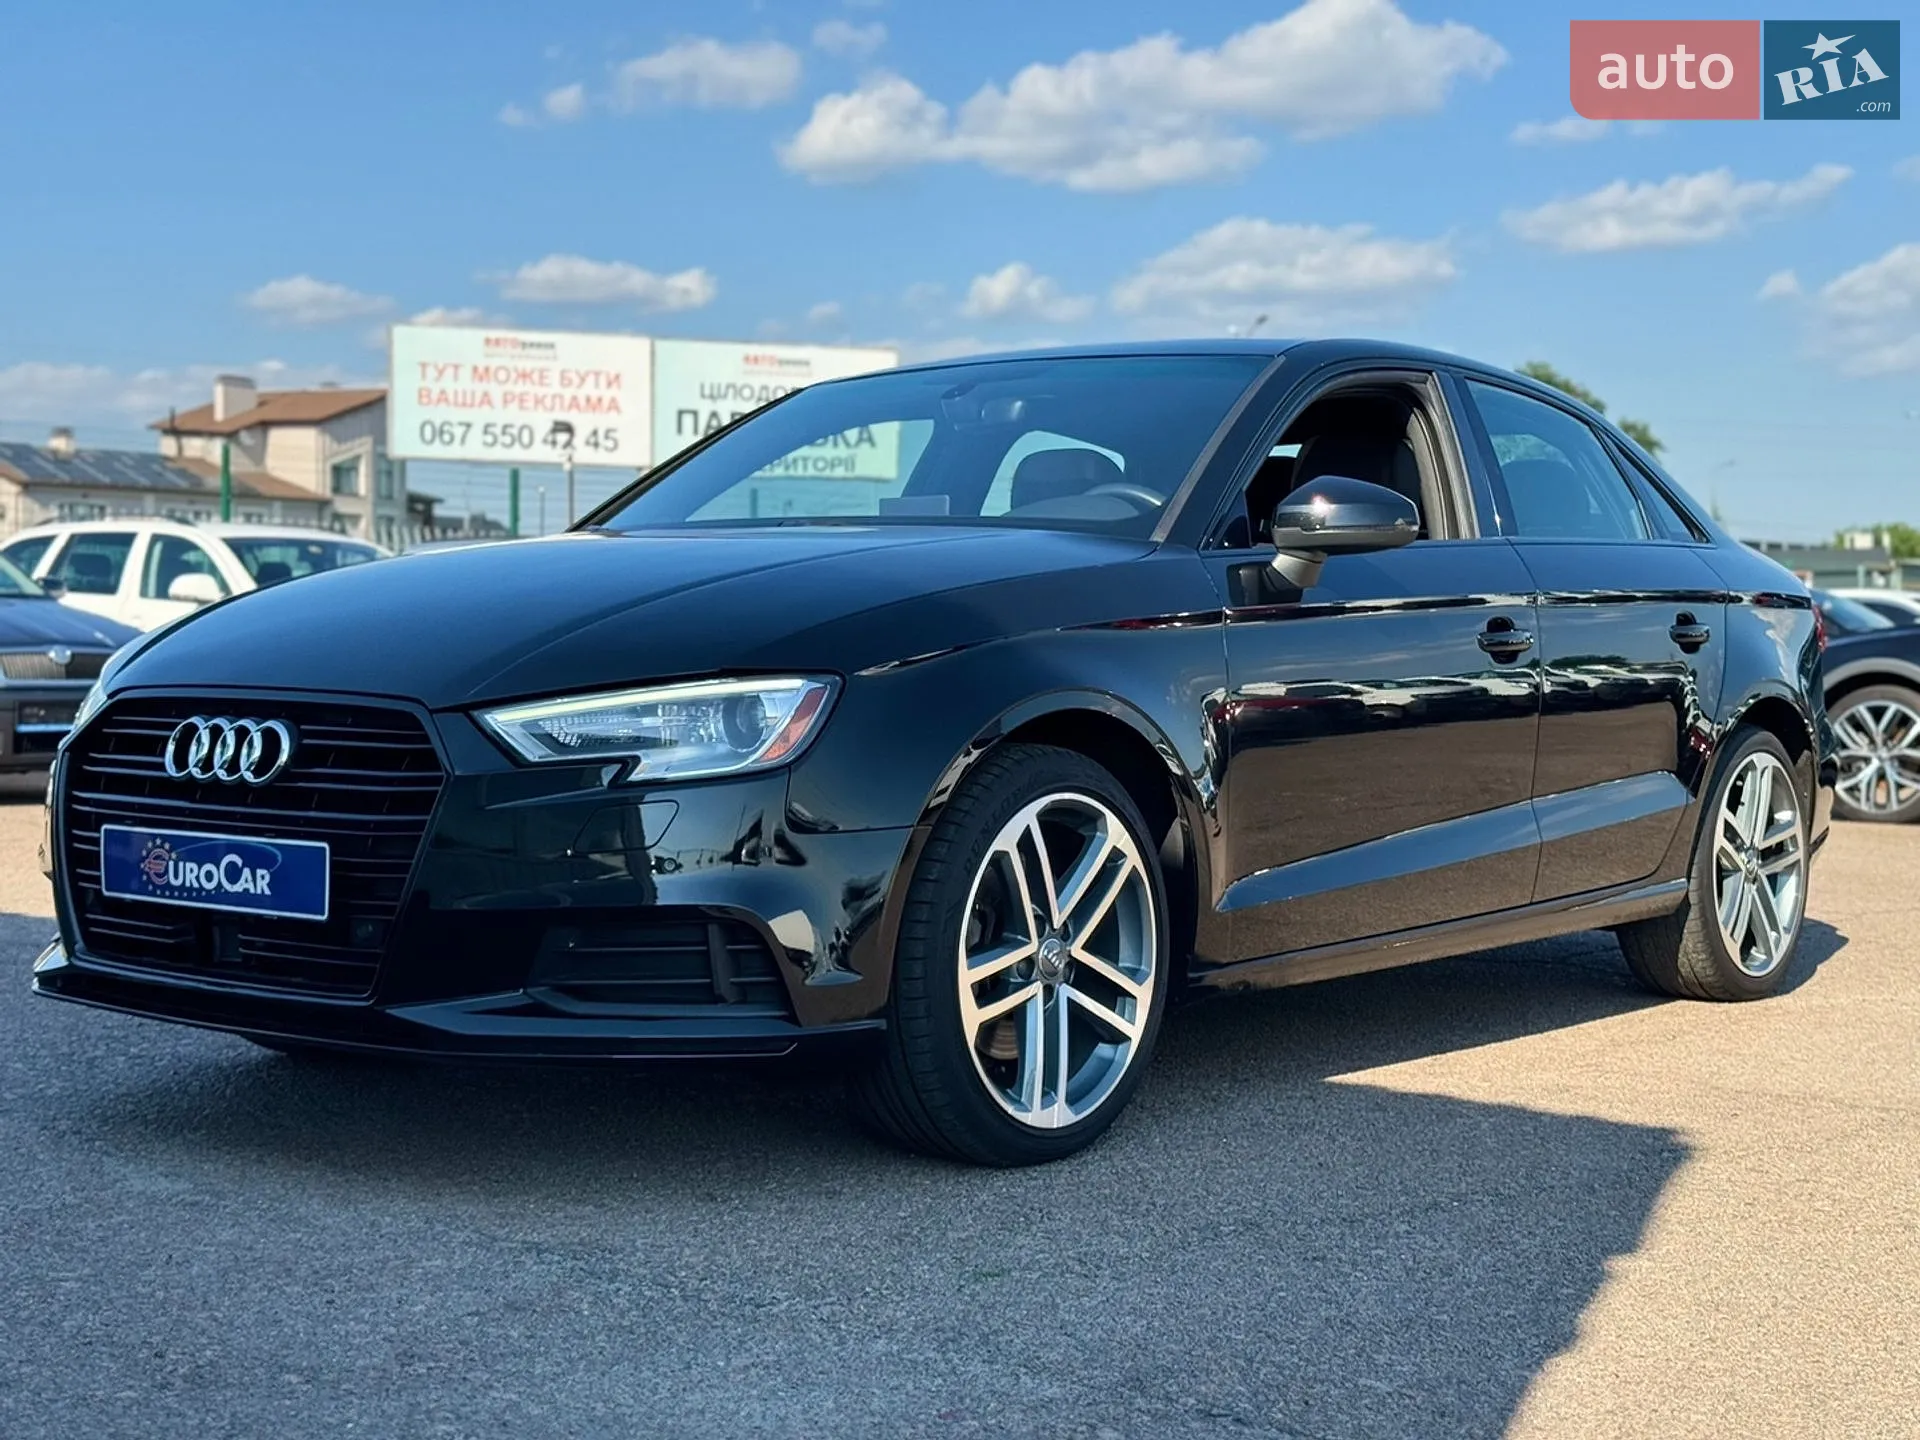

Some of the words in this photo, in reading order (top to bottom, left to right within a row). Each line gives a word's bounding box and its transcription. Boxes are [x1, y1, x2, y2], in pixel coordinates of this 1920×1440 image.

[417, 362, 464, 383] ТУТ
[472, 364, 552, 387] МОЖЕ
[560, 369, 622, 390] БУТИ
[417, 388, 495, 410] ВАША
[502, 390, 622, 414] РЕКЛАМА
[700, 382, 803, 404] ЦІЛОДО
[419, 420, 472, 446] 067
[482, 423, 534, 449] 550
[584, 427, 619, 452] 45
